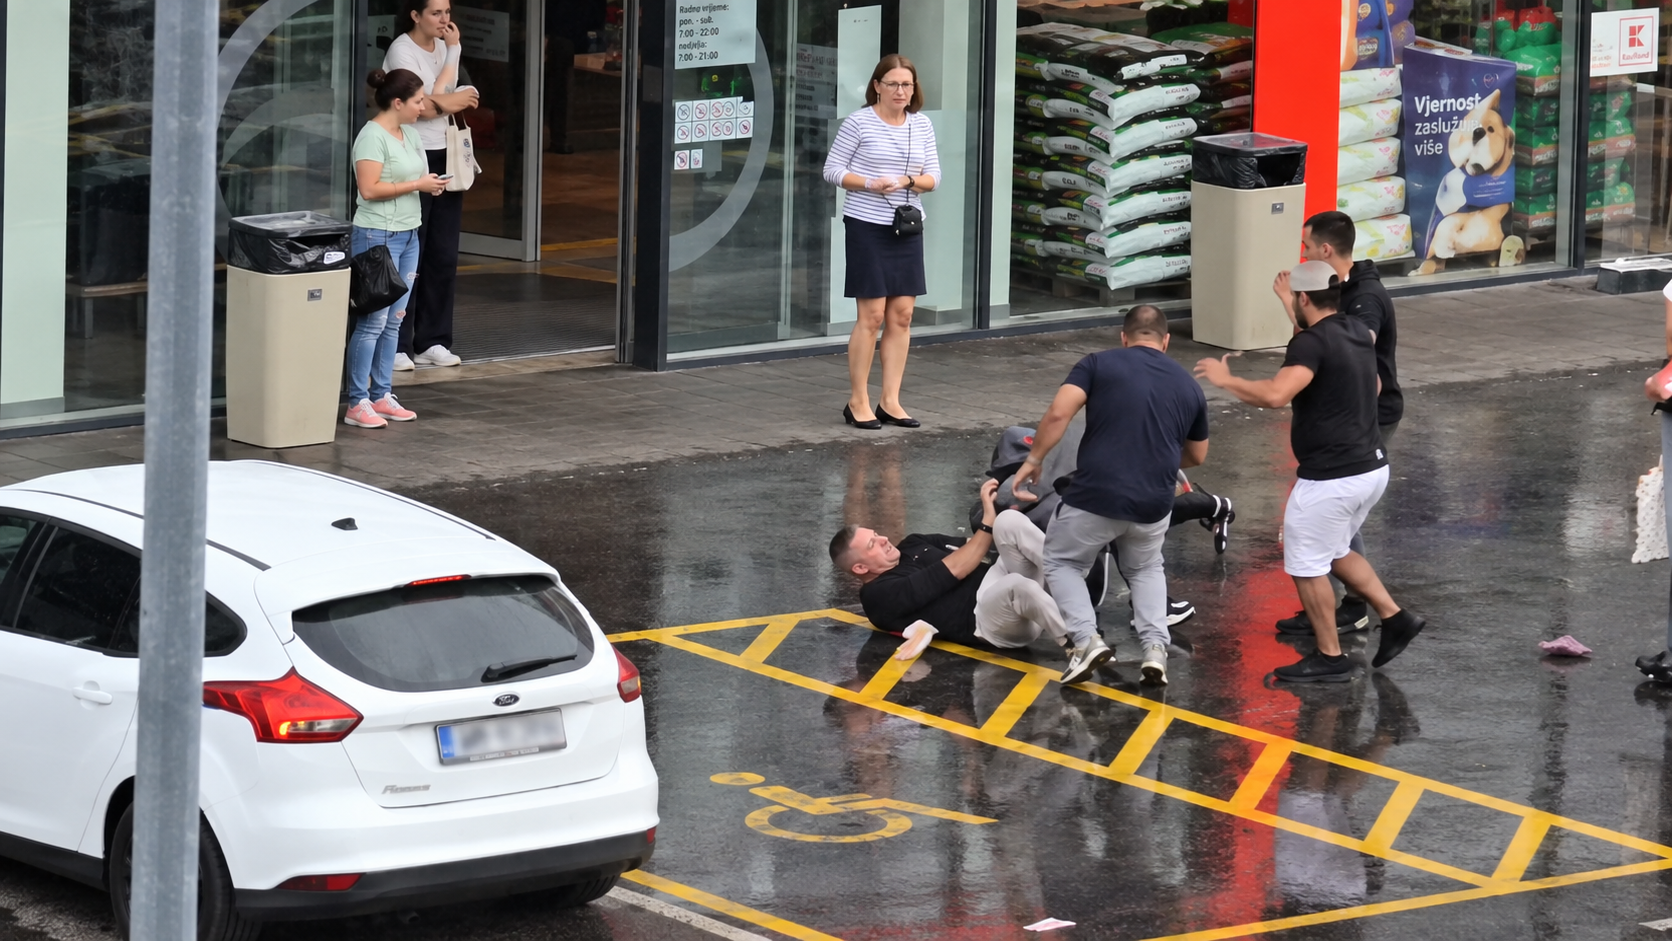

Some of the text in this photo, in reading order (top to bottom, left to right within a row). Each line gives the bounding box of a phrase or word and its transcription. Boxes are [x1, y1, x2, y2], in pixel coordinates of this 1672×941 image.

[679, 3, 730, 14] Radno vrijeme:
[679, 18, 694, 28] pon.
[698, 51, 719, 61] 21:00
[1414, 93, 1482, 117] Vjernost
[1414, 139, 1444, 156] više
